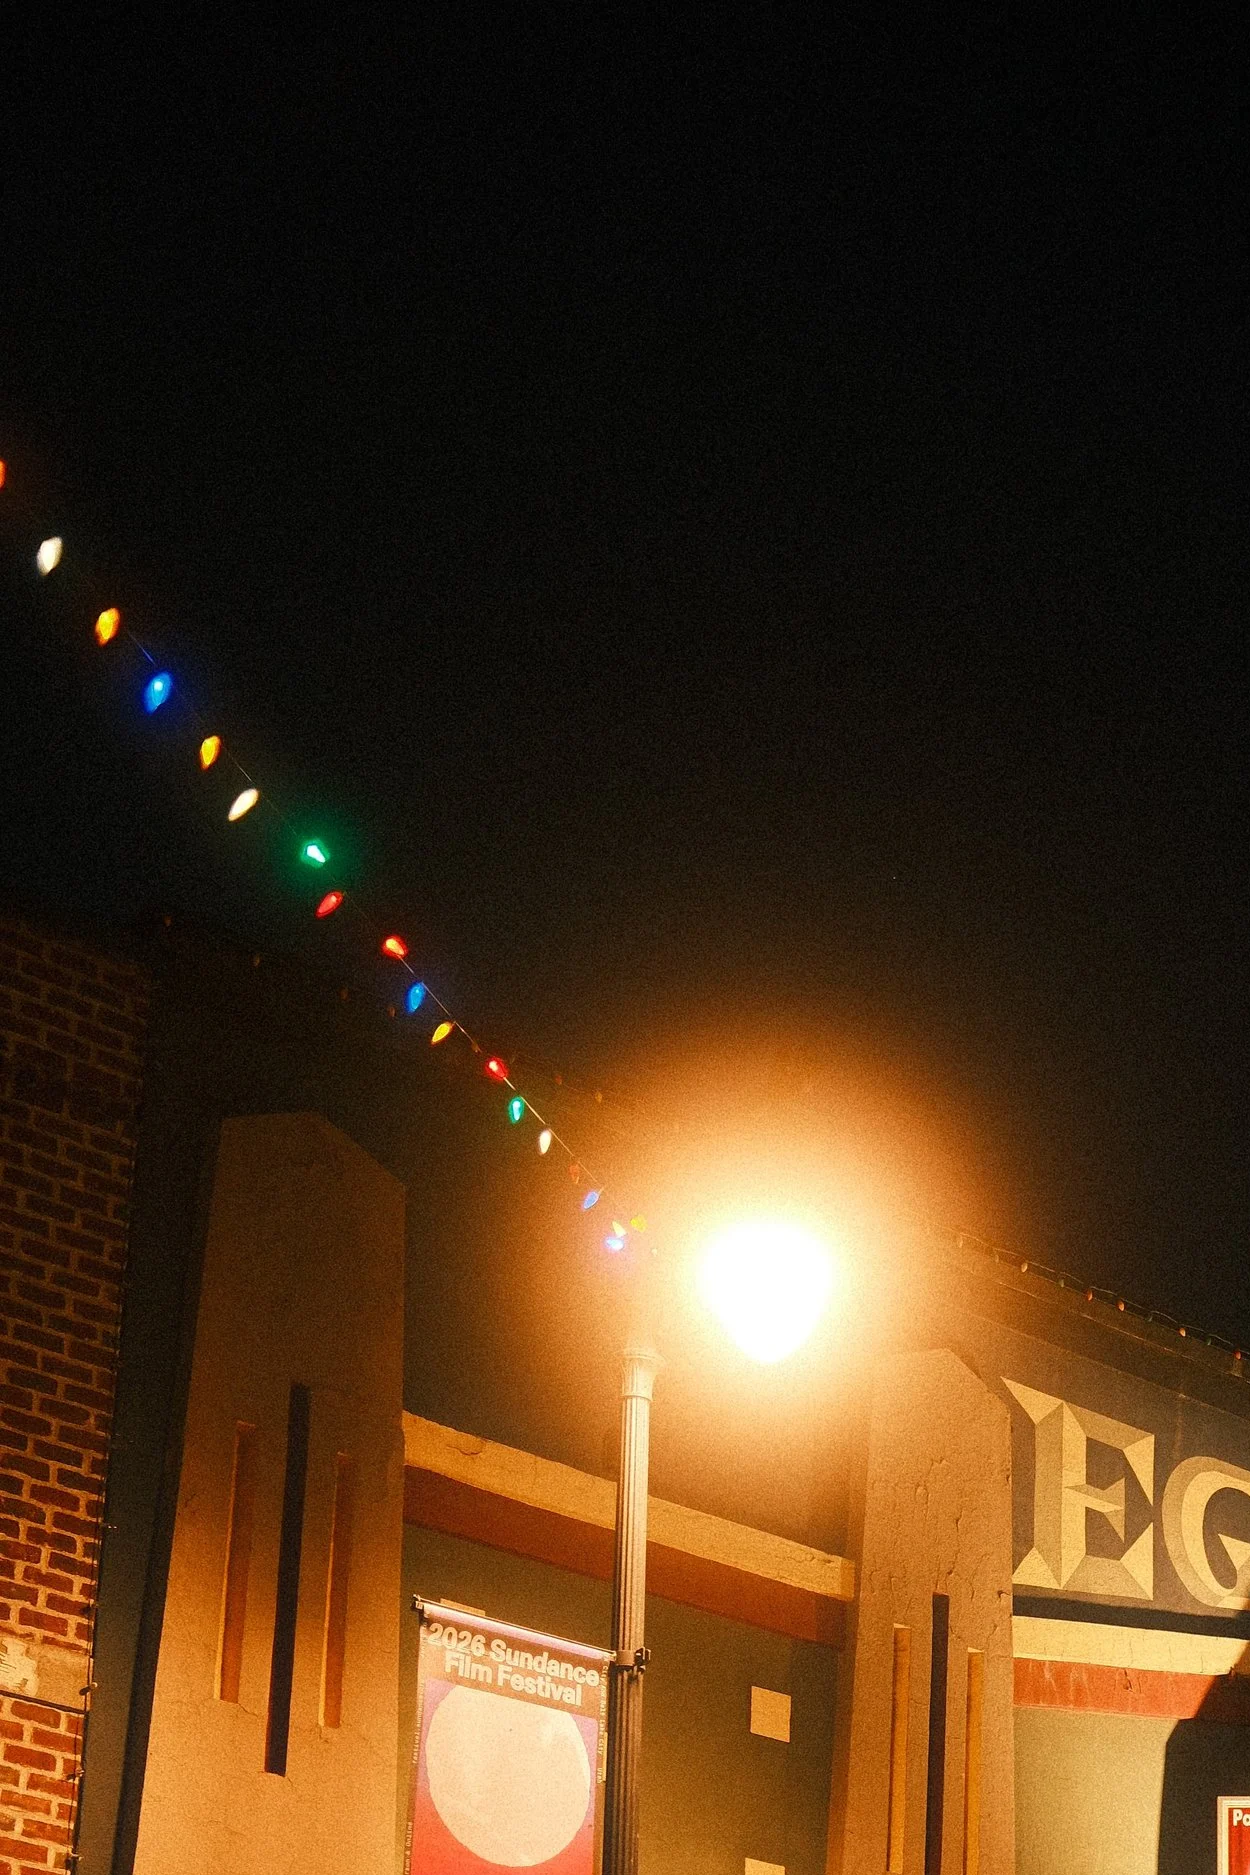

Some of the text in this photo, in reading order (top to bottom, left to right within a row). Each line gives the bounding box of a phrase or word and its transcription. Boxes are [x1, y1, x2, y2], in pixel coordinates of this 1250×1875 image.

[428, 1622, 486, 1657] 2026
[489, 1639, 600, 1687] Sundance
[445, 1651, 582, 1707] Film Festival
